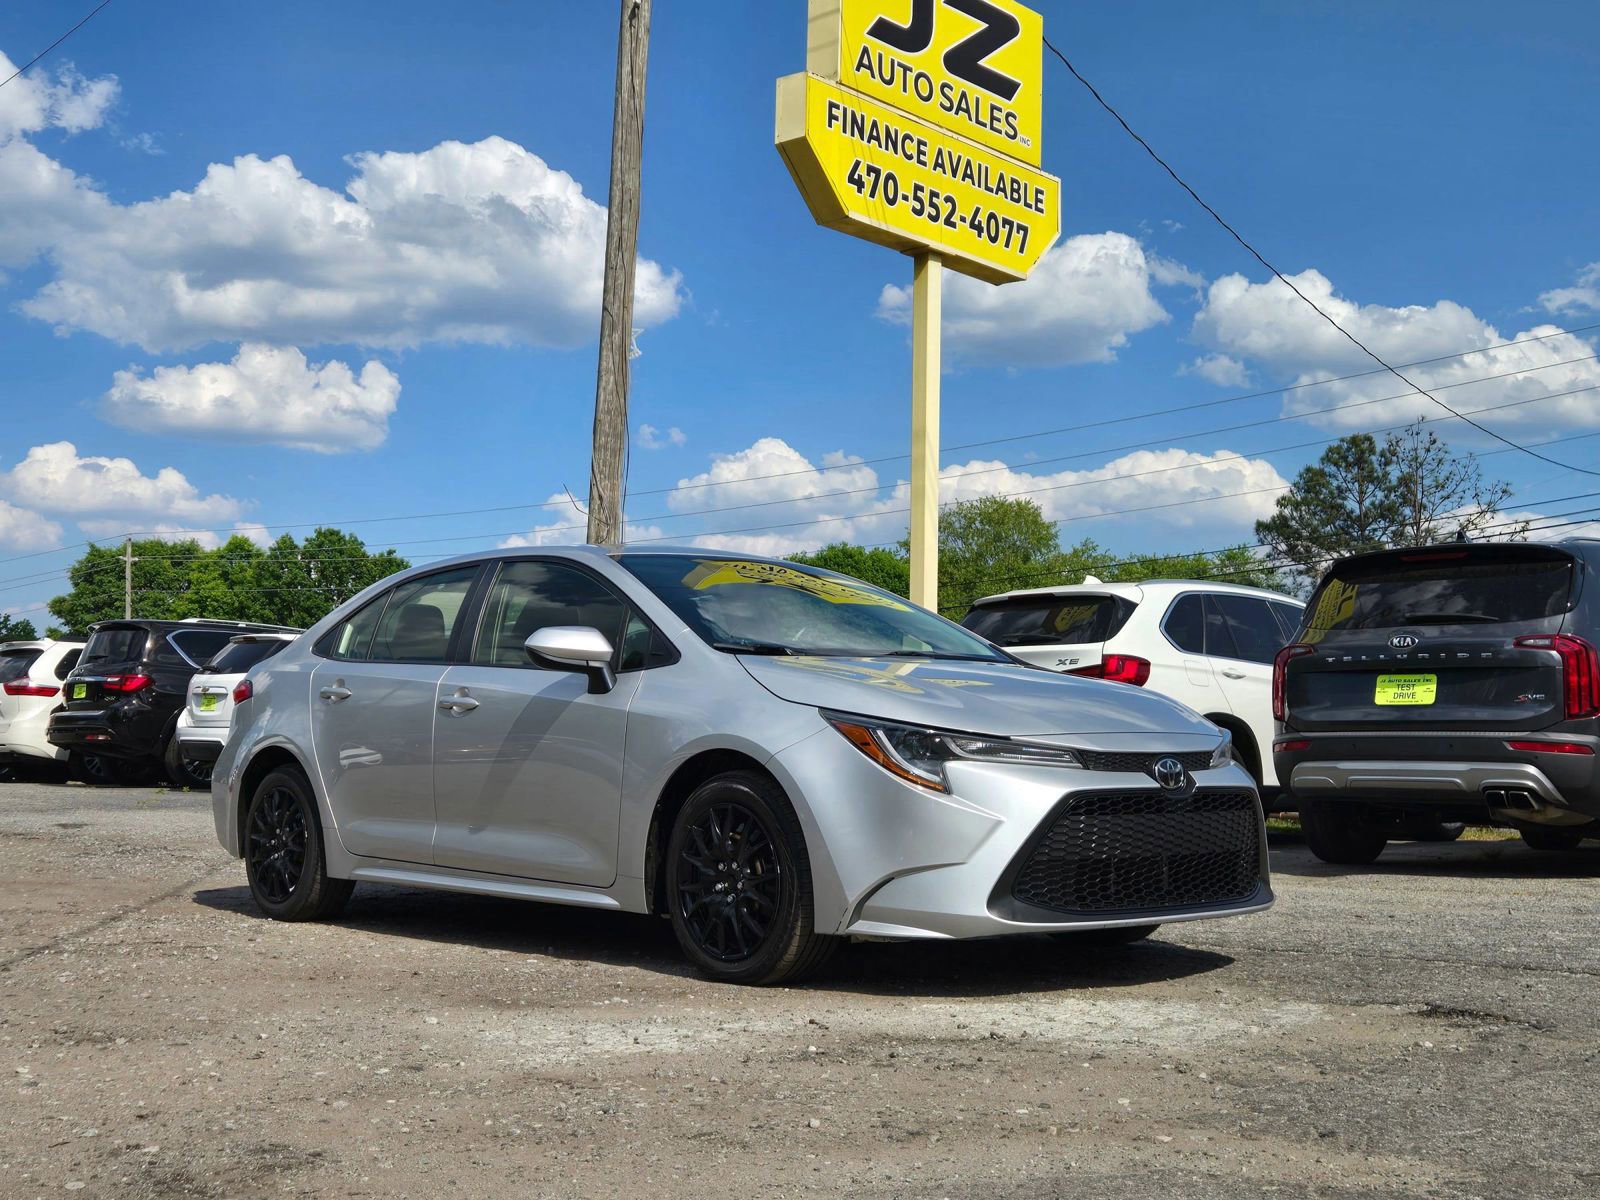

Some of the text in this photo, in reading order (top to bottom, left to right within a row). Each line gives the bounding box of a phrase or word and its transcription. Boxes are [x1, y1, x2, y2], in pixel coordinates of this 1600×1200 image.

[855, 45, 1031, 147] AUTO SALES INC
[827, 99, 1045, 214] FINANCE AVAILABLE
[847, 159, 1029, 254] 470-552-4077
[1325, 652, 1493, 662] TELLURIDE
[1392, 636, 1412, 647] KIA
